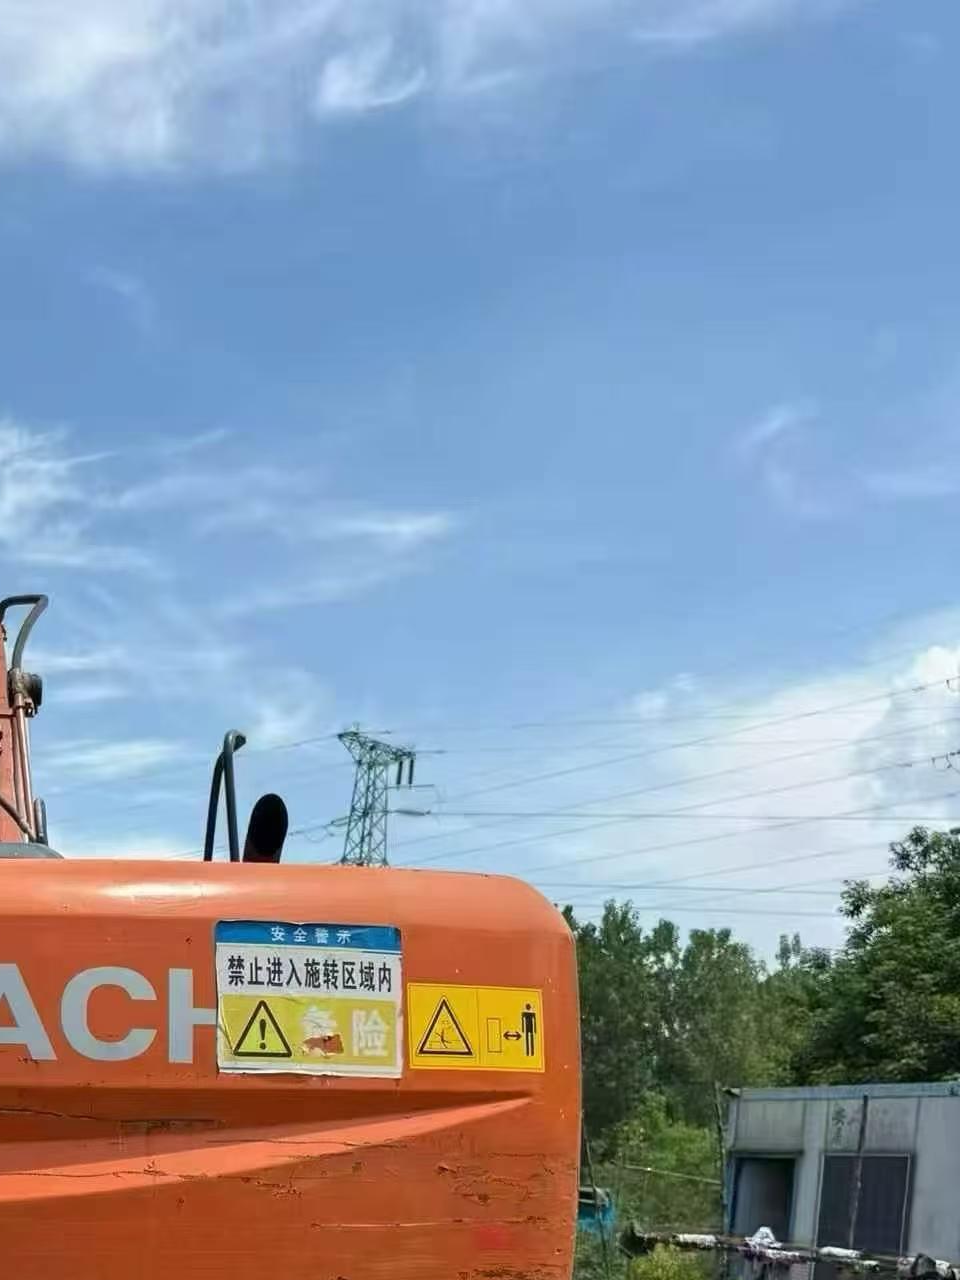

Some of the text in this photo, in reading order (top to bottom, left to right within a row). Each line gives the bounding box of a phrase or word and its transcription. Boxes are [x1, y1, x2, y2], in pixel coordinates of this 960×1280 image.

[271, 926, 352, 944] 安全警示
[228, 955, 391, 992] 禁止进入施转区域内
